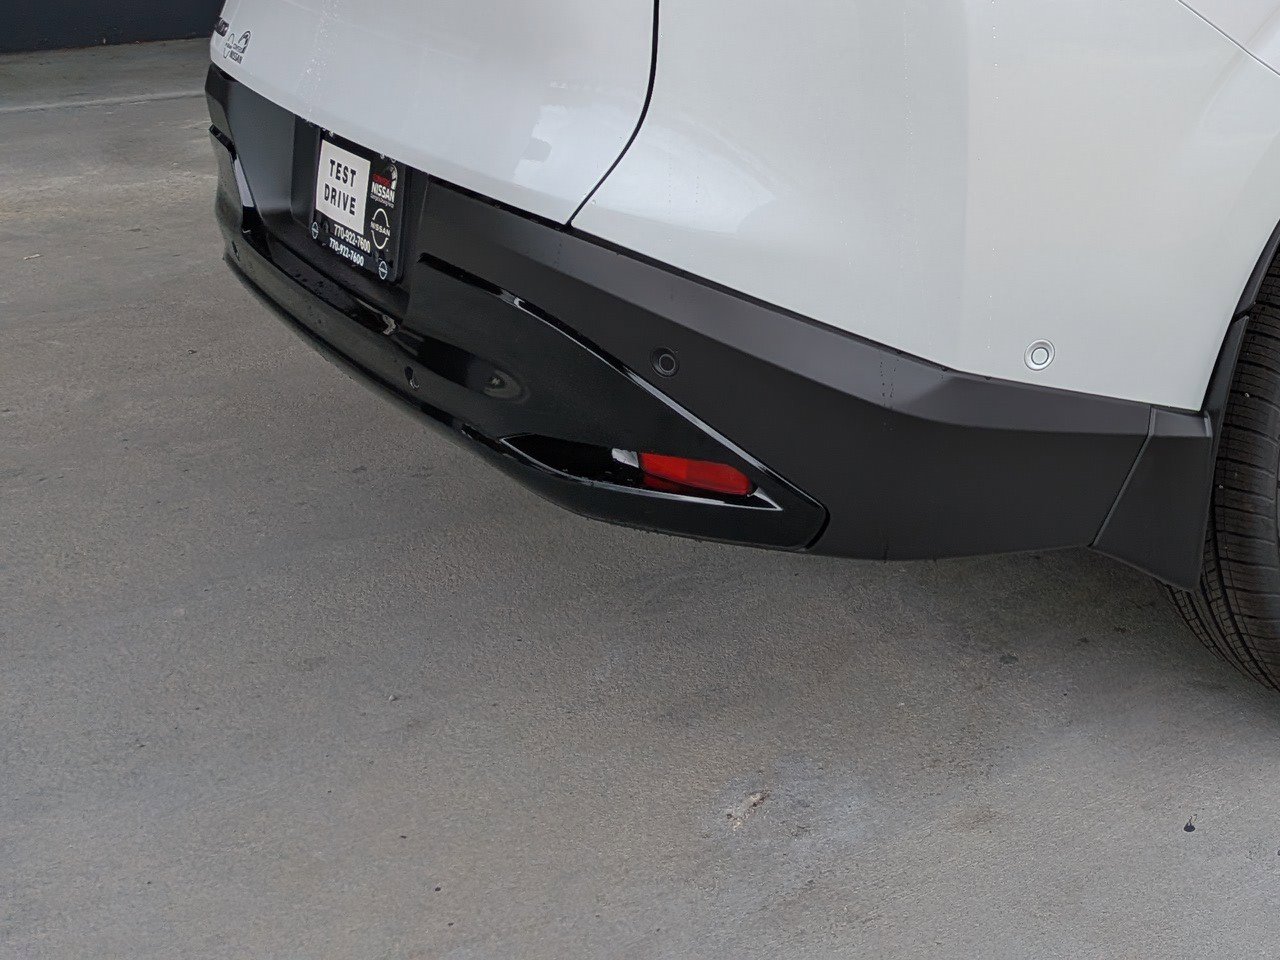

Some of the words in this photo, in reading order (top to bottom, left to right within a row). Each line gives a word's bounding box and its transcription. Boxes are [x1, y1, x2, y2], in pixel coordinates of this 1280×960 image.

[329, 159, 357, 188] TEST
[324, 182, 356, 216] DRIVE
[371, 181, 395, 203] NISSAN
[334, 224, 371, 253] 770-922-7600
[370, 221, 391, 237] NISSAN
